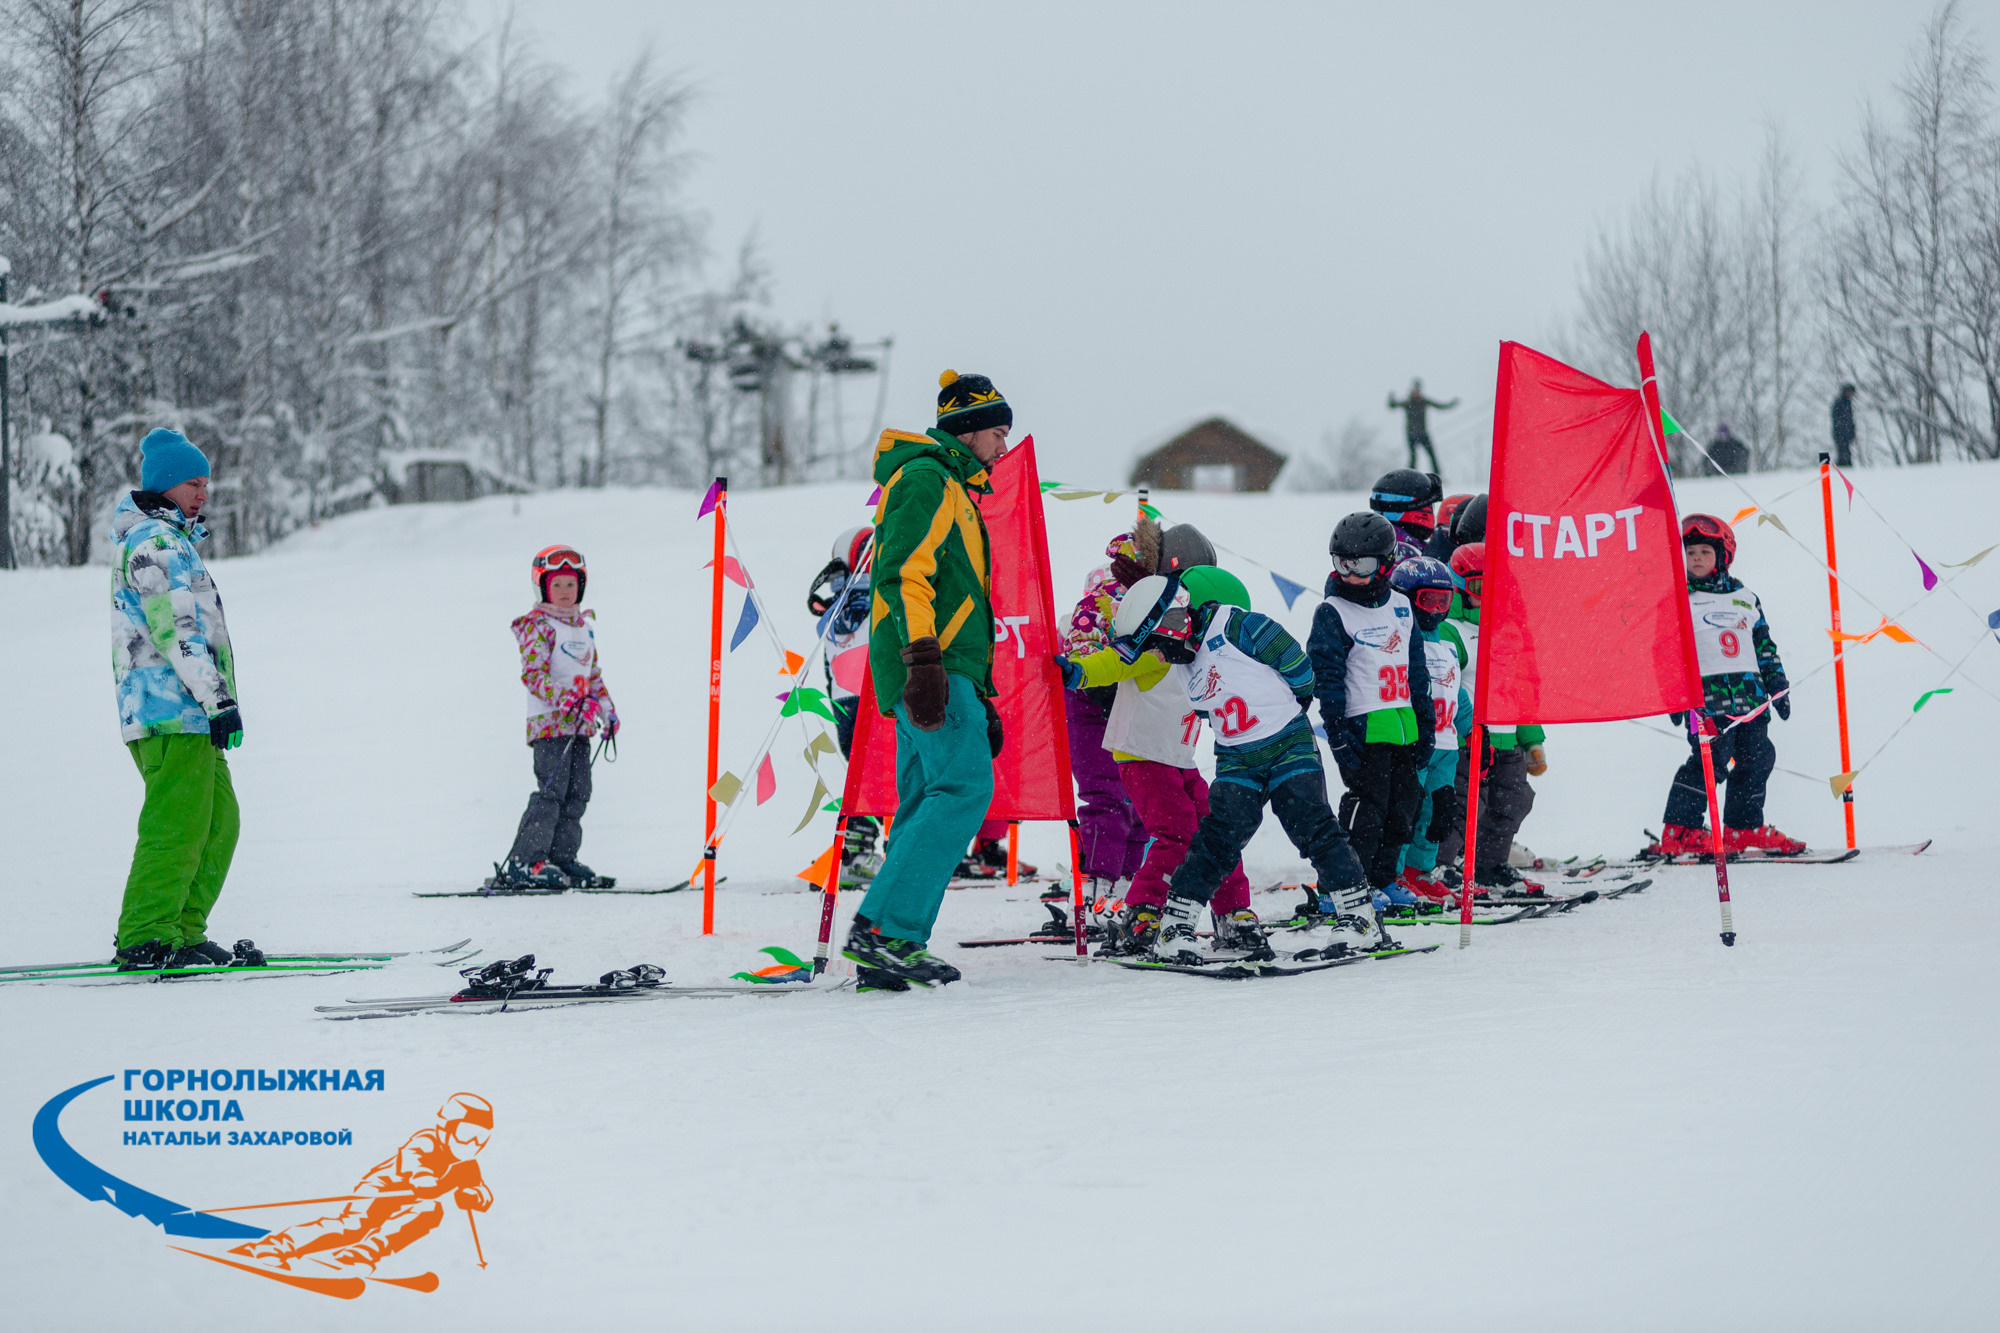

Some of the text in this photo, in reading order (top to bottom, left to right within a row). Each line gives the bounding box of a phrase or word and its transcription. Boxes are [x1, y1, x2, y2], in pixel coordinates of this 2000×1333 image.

[1507, 505, 1643, 559] СТАРТ
[1719, 630, 1740, 658] 9
[1378, 664, 1410, 702] 35
[1213, 696, 1260, 736] 22
